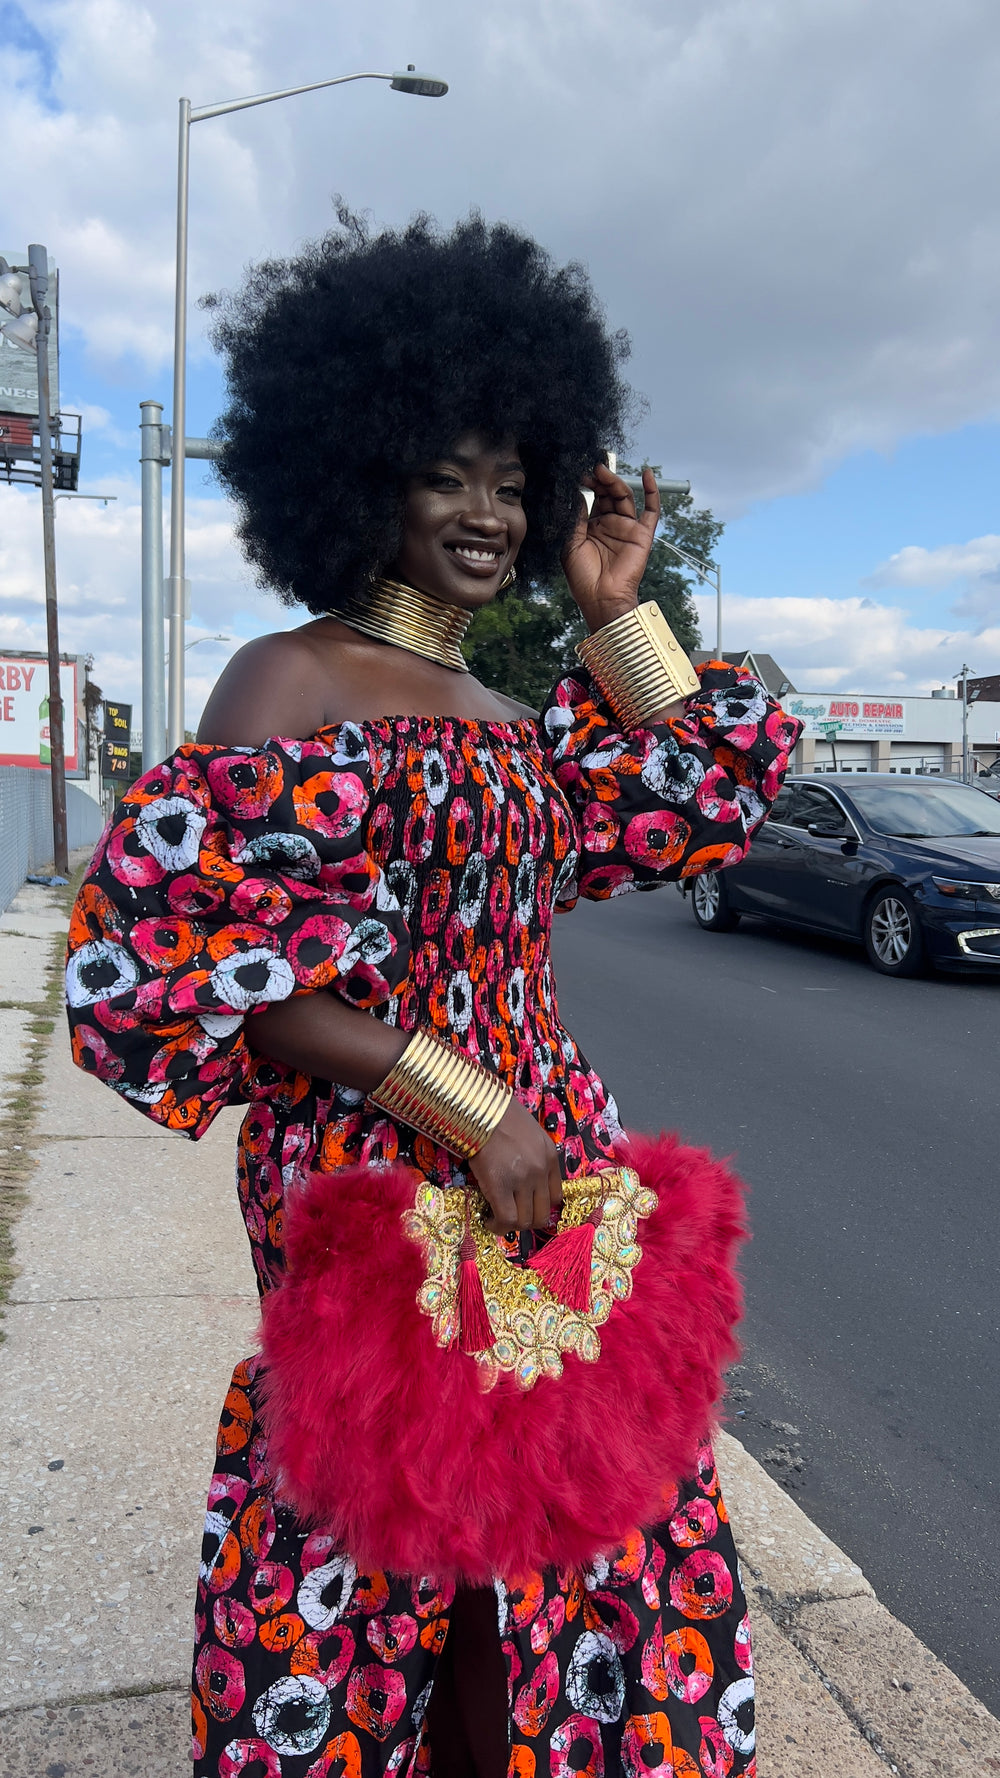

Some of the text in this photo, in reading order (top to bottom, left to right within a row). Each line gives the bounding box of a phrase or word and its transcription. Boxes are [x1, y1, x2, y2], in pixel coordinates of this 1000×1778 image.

[0, 696, 15, 721] E
[108, 706, 118, 717] TOP
[828, 701, 859, 717] AUTO
[863, 702, 903, 719] REPAIR
[114, 717, 127, 729] SOIL
[107, 743, 128, 757] 3 BAGS
